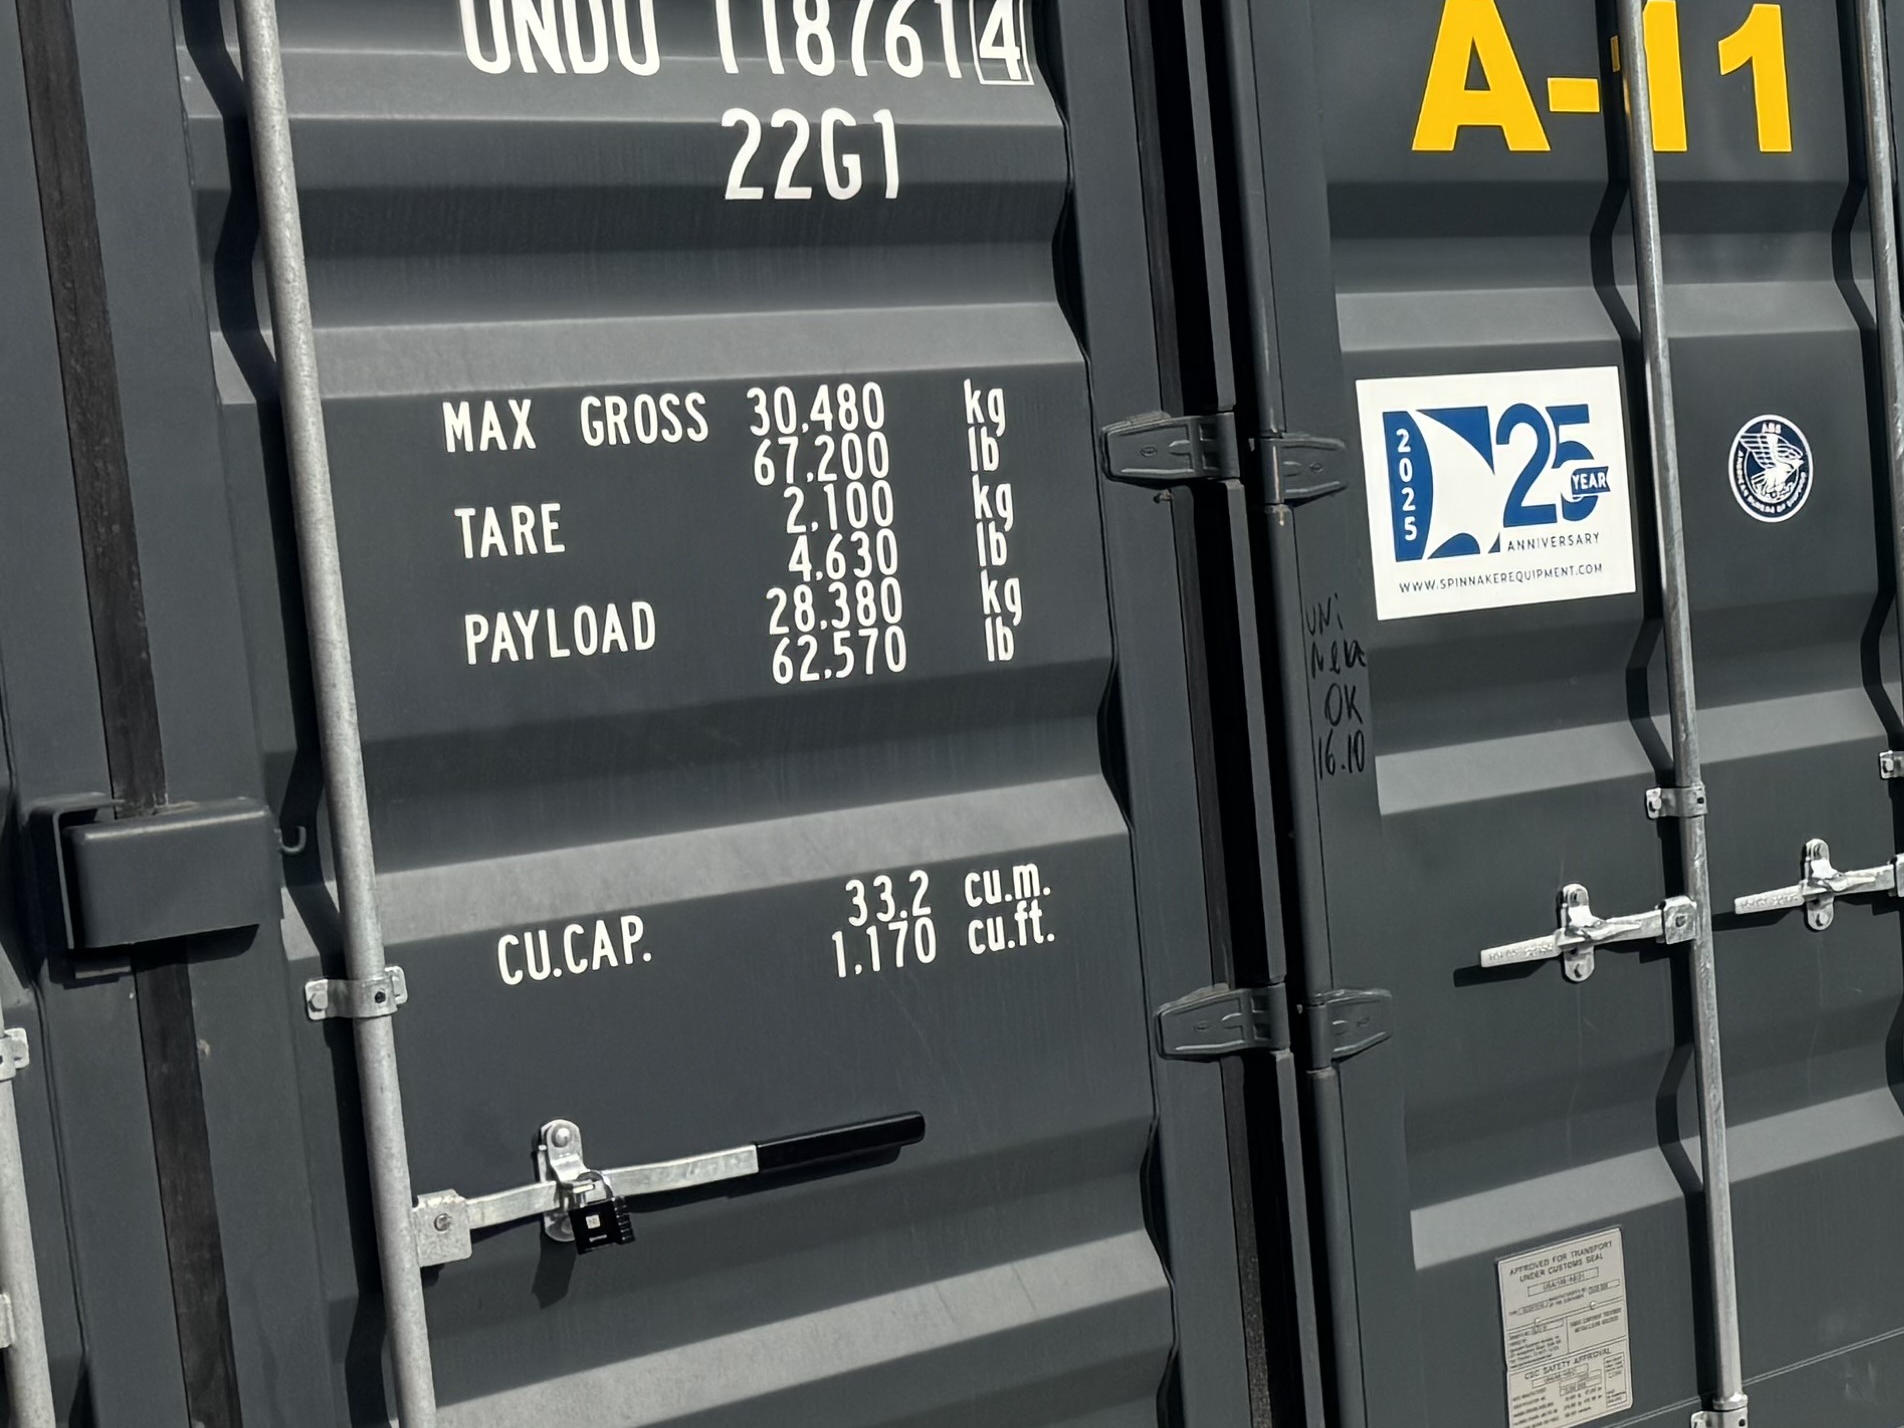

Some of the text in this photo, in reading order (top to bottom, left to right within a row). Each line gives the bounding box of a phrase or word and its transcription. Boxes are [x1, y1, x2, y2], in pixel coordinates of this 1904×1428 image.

[722, 107, 898, 199] 22G1
[443, 379, 1005, 452] MAX GROSS 30,480 kg
[755, 426, 998, 485] 67,200 lb
[1395, 428, 1419, 541] 2025
[1572, 472, 1607, 491] YEAR
[455, 475, 1013, 558] TARE 2,100 kg
[1507, 532, 1601, 553] ANNIVERSARY
[789, 521, 1007, 581] 4,630 lb
[1398, 563, 1605, 594] WWW.SPINNAKEREQUIPMENT.COM
[465, 570, 1021, 664] PAYLOAD 28,380 kg
[773, 616, 1014, 684] 62,570 lb
[1325, 683, 1363, 726] OK
[965, 864, 1050, 907] cu.m.
[832, 917, 935, 977] 1,170
[969, 894, 1054, 954] cu.ft.
[1509, 1240, 1613, 1276] APPROVED FOR TRANSPORT
[1547, 1259, 1583, 1275] CUSTOMS
[1585, 1253, 1604, 1266] SEAL
[1542, 1360, 1571, 1375] SAFETY
[1573, 1348, 1611, 1368] APPROVAL
